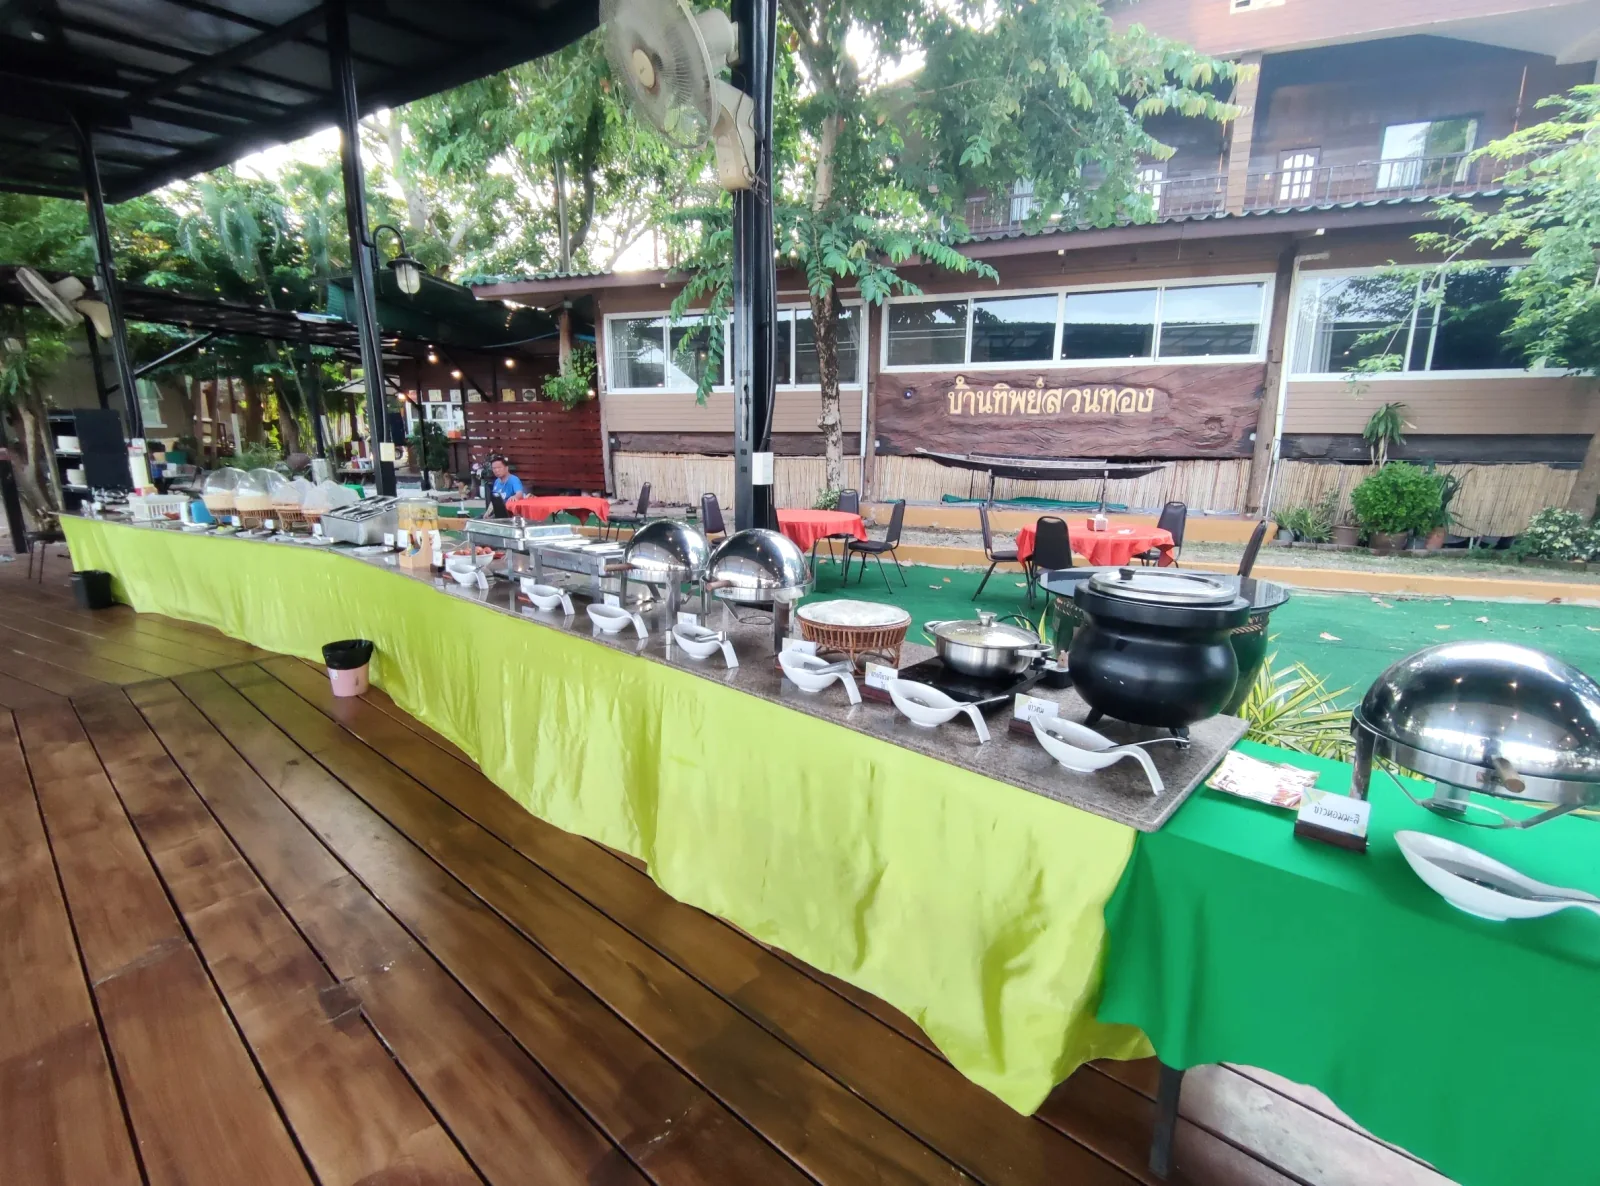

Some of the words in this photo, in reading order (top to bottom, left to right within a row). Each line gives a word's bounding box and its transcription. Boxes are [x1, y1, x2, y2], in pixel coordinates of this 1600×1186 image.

[948, 376, 1154, 416] บ้านทิพย์สวนทอง
[1314, 801, 1361, 825] ข้าวหอมมะลิ
